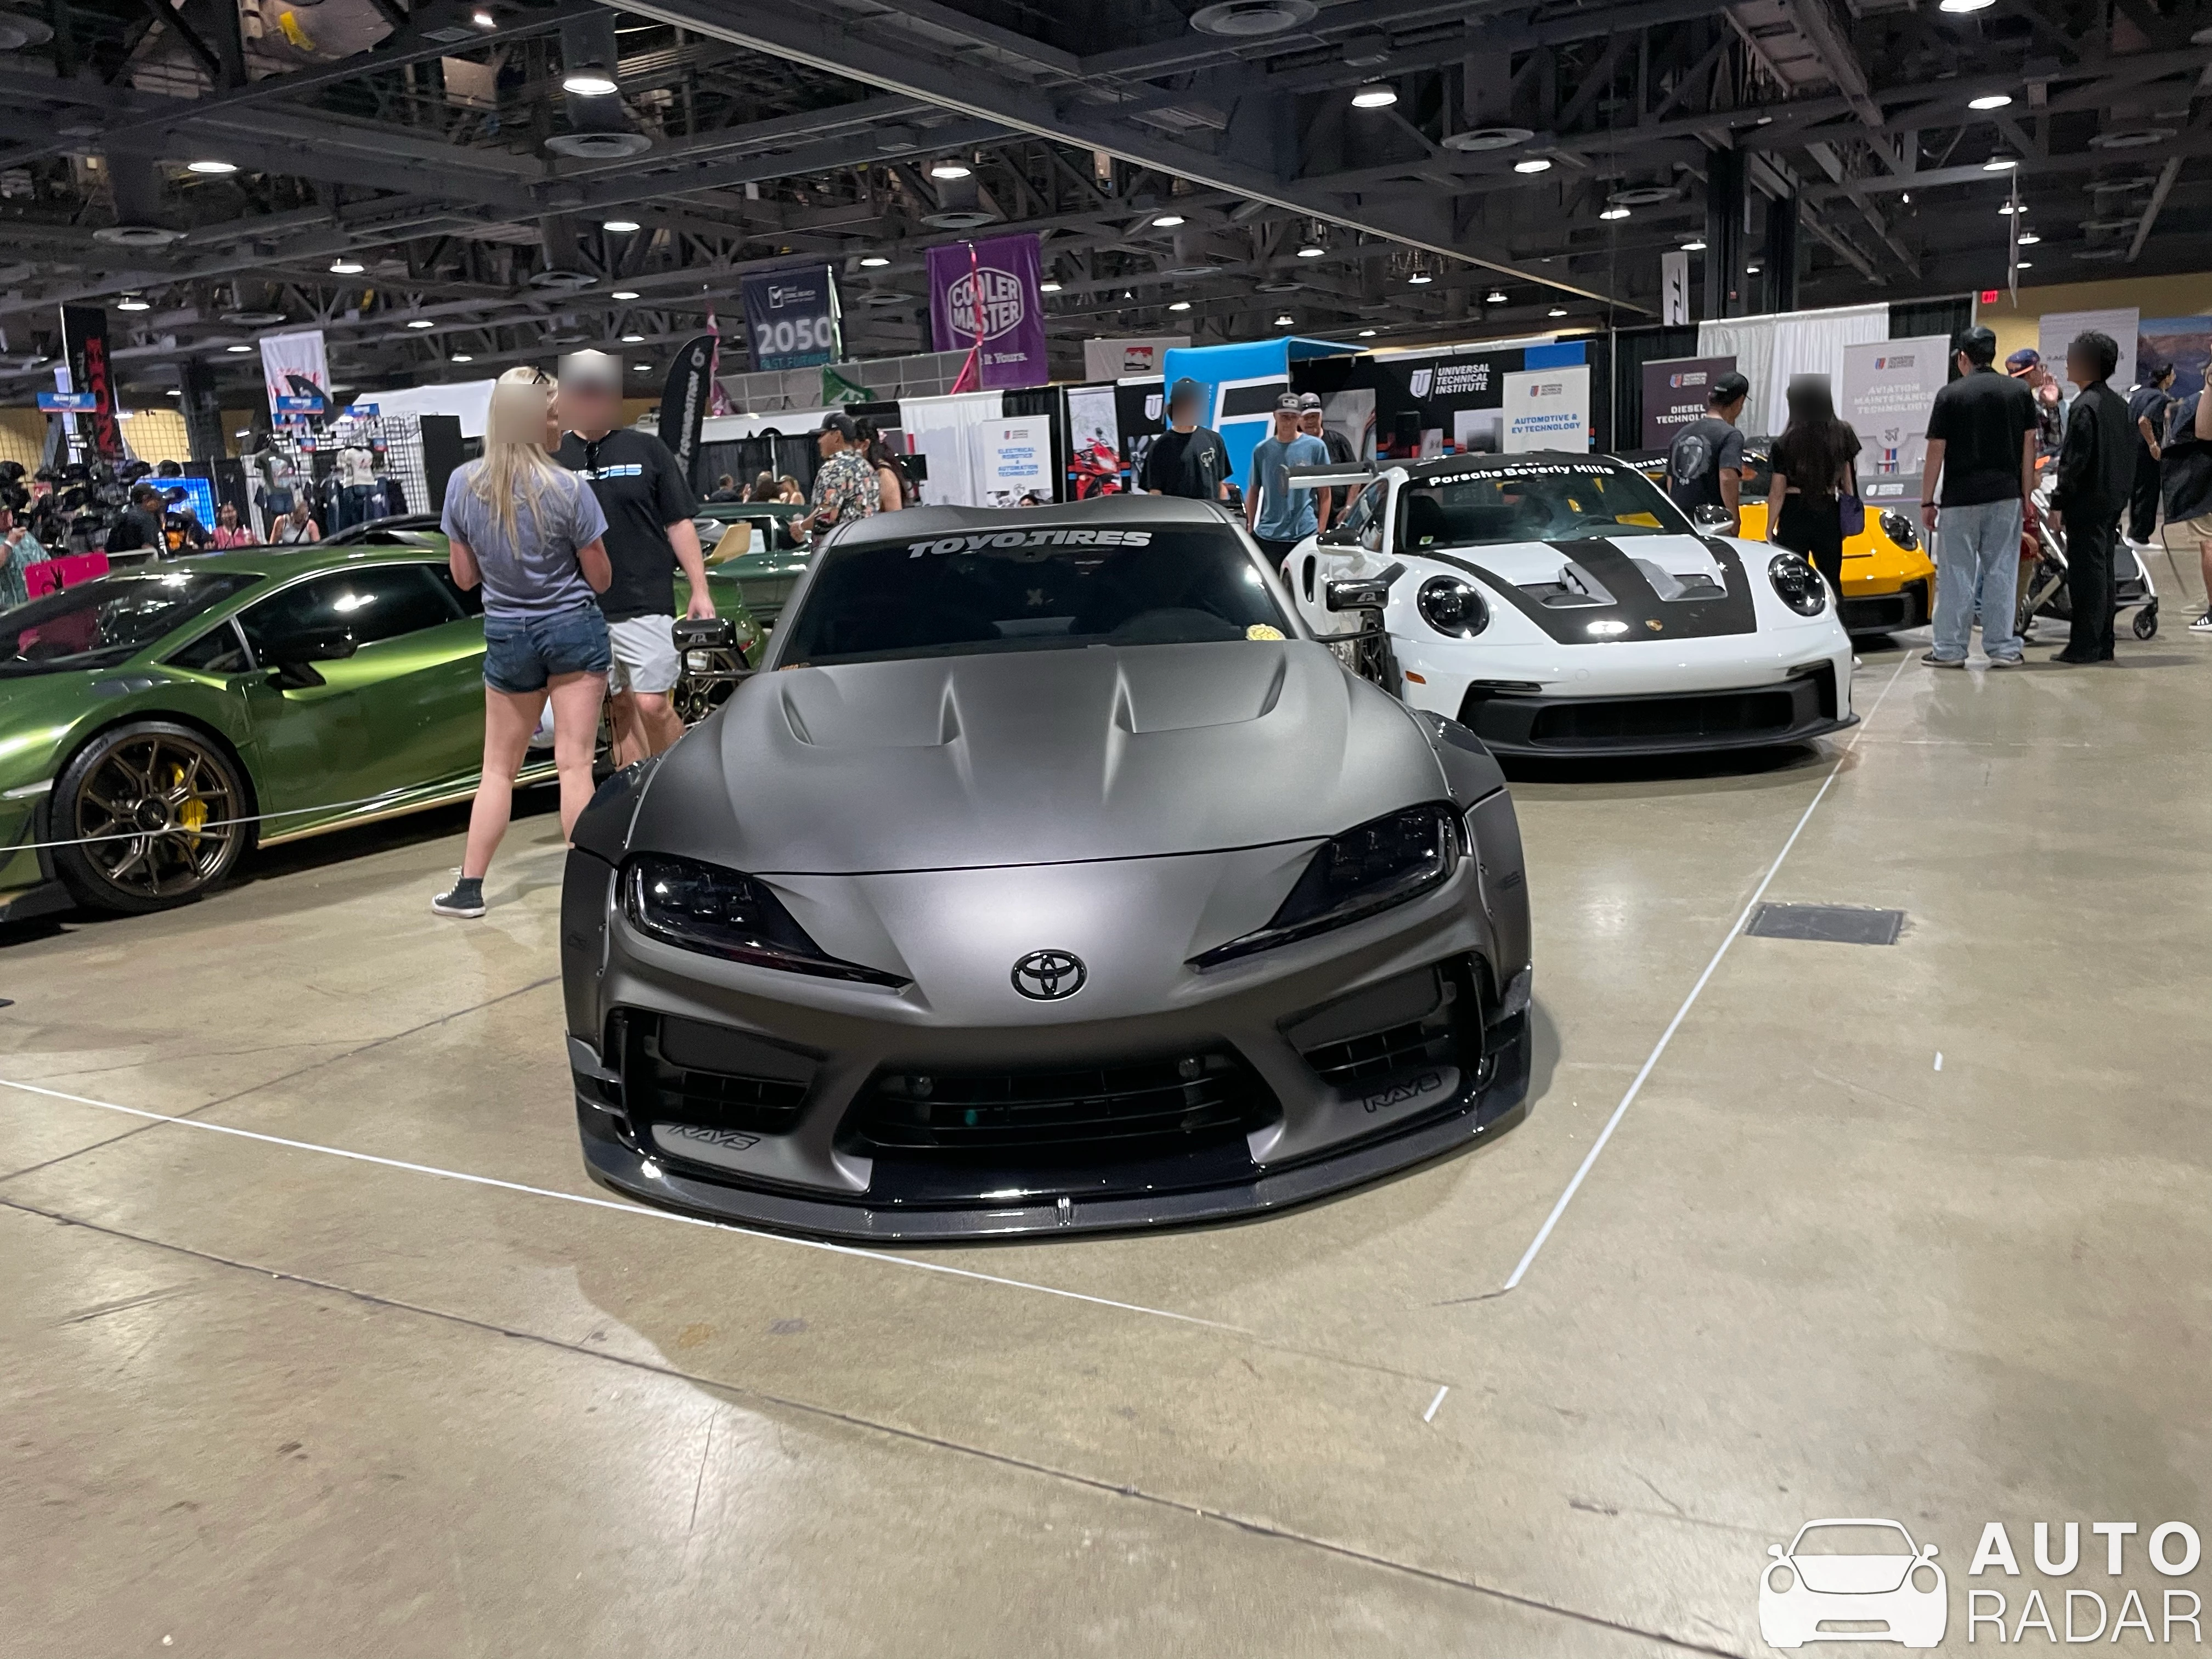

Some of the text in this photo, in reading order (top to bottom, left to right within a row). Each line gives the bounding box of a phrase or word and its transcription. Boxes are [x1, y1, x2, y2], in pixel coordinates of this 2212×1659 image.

[952, 273, 1018, 307] COOLER
[953, 301, 1019, 334] MASTER
[757, 316, 832, 354] 2050
[1438, 363, 1490, 376] UNIVERSAL
[1436, 373, 1488, 385] TECHNICAL
[1435, 382, 1487, 394] INSTITUTE
[1867, 383, 1920, 395] AVIATION
[1671, 404, 1706, 414] DIESEL
[1514, 414, 1569, 425] AUTOMOTIVE
[1525, 422, 1581, 433] TECHNOLOGY
[1429, 465, 1615, 487] Porsche Beverly Hills
